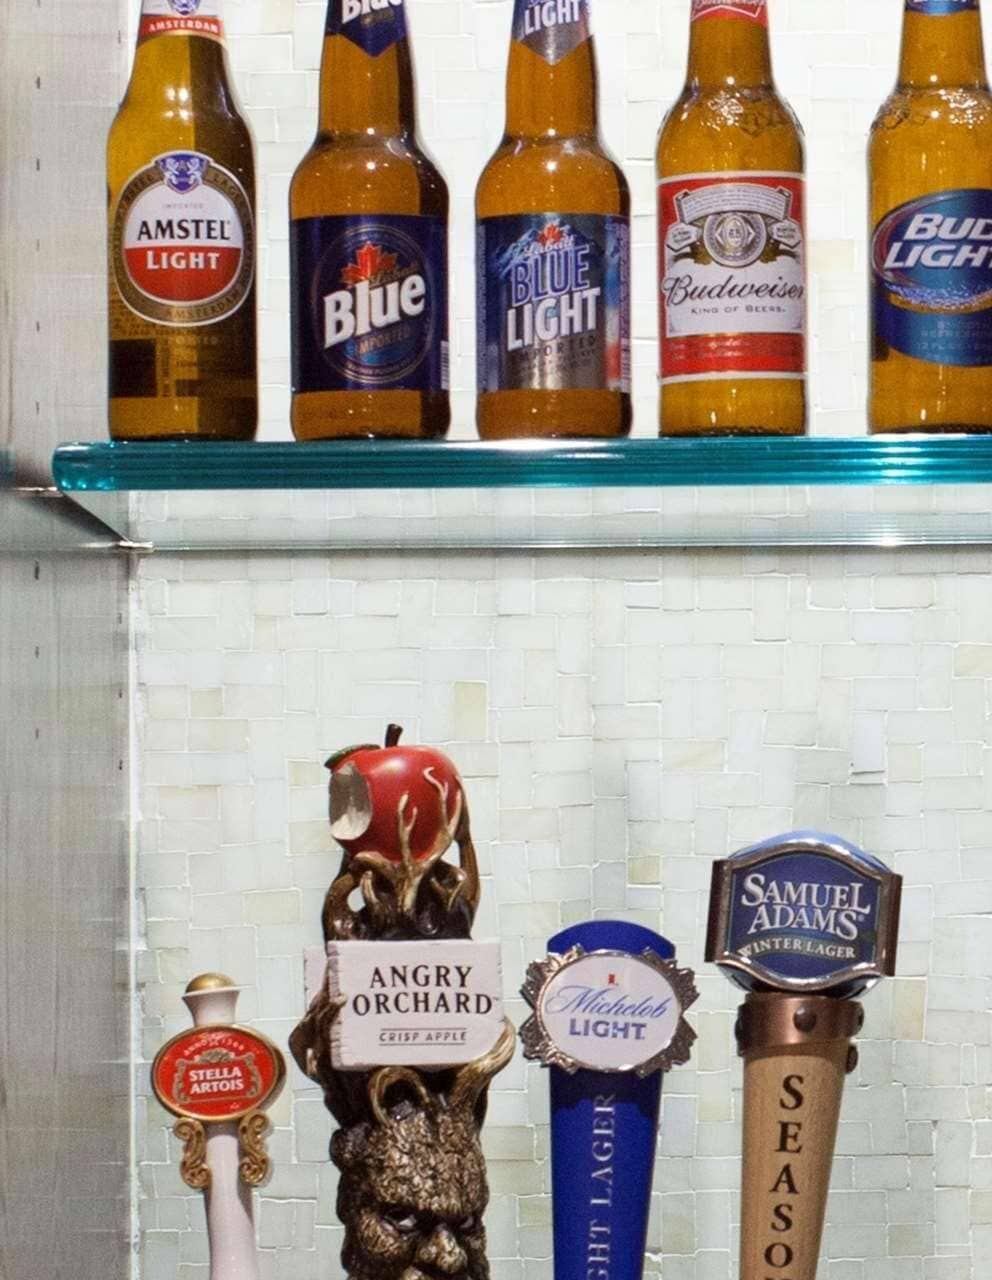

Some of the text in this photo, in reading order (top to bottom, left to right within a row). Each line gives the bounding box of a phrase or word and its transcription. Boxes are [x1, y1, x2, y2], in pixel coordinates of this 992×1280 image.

[137, 219, 231, 241] AMSTEL
[146, 250, 220, 270] LIGHT
[511, 243, 591, 308] BLUE
[323, 274, 426, 350] Blue
[506, 286, 602, 352] LIGHT
[724, 305, 740, 313] OF
[741, 873, 872, 915] SAMUEL
[747, 904, 859, 941] ADAMS
[737, 936, 856, 959] WINTER LAGER
[370, 964, 473, 989] ANGRY
[352, 991, 493, 1017] ORCHARD
[545, 985, 673, 1019] Michelob
[378, 1031, 468, 1043] CRISP APPLE
[568, 1018, 647, 1041] LIGHT
[188, 1066, 243, 1082] STELLA
[190, 1078, 245, 1095] ARTOIS
[590, 1093, 617, 1208] LAGER
